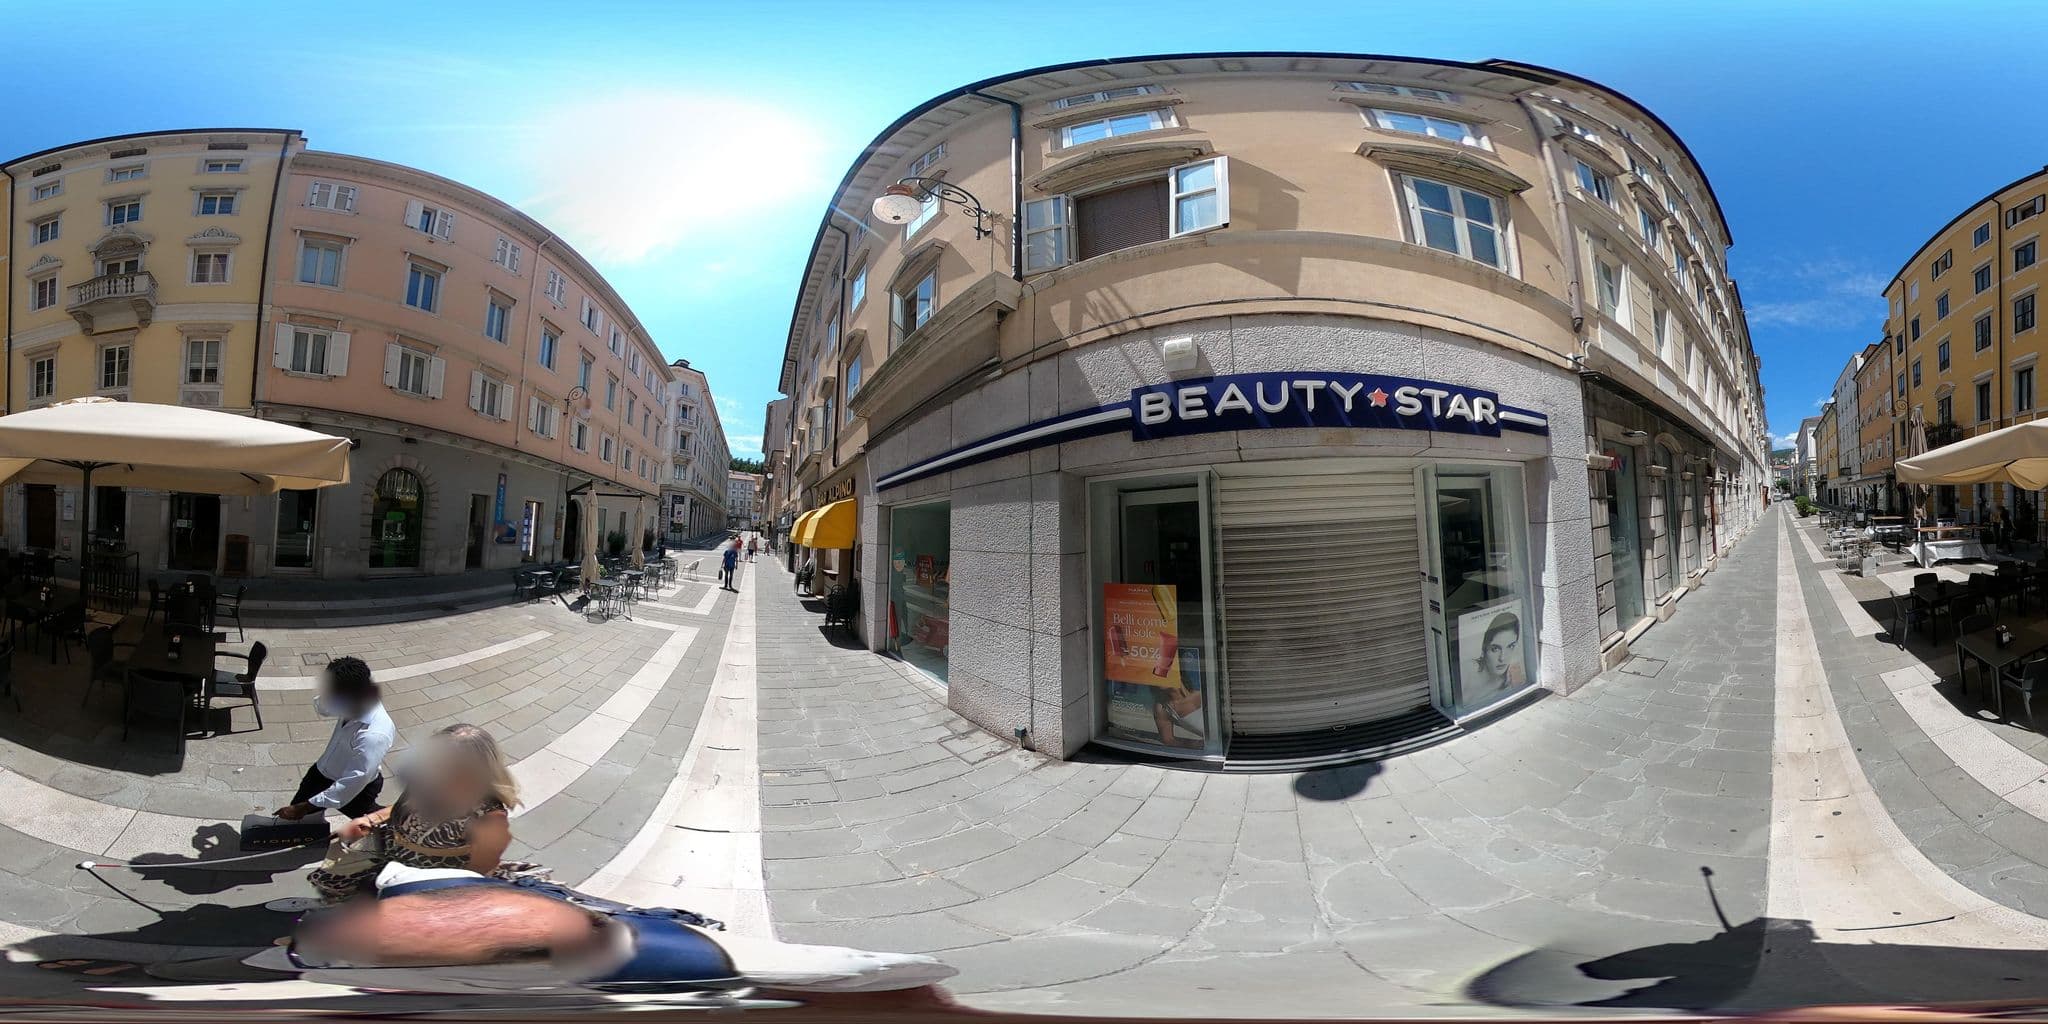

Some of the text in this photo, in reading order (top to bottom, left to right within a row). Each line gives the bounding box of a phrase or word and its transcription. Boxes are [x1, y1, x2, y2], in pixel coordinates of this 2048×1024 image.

[1140, 380, 1498, 426] BEAUTY STAR
[828, 478, 852, 502] ALPINO
[1113, 613, 1168, 628] Belli come
[1134, 626, 1154, 638] sole
[1121, 646, 1161, 660] -50%
